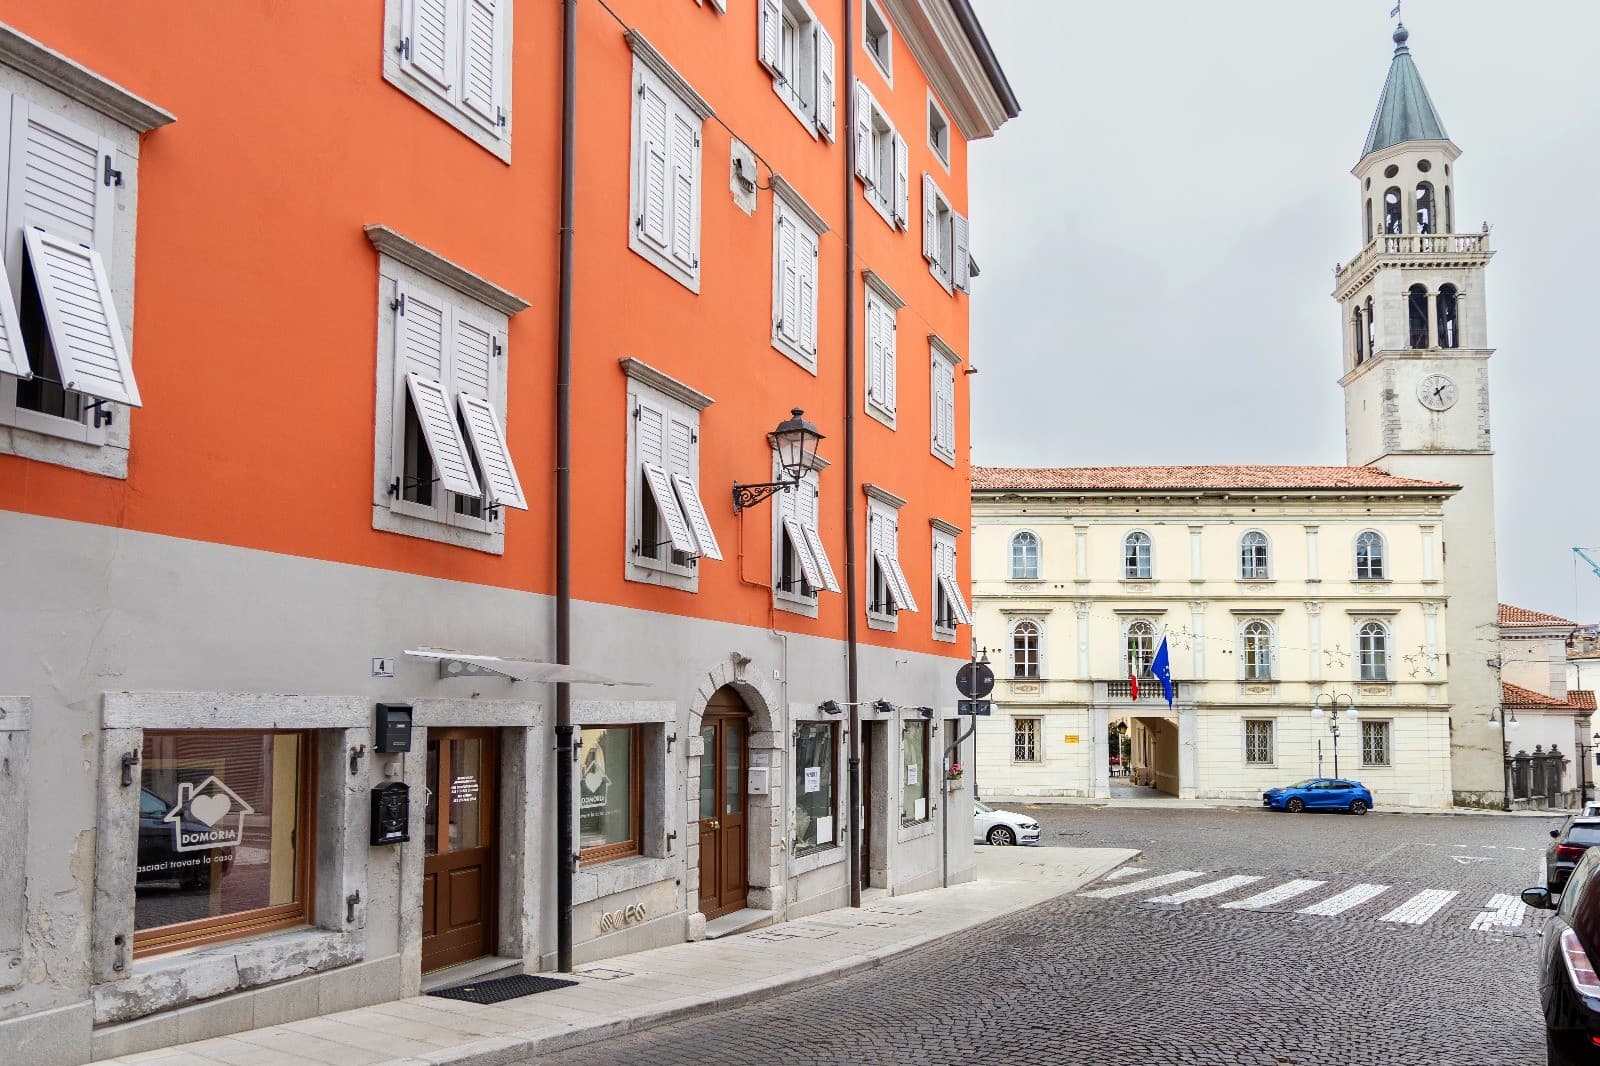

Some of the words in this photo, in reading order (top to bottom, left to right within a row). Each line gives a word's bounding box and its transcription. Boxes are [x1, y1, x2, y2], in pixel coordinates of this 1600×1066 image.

[182, 829, 236, 844] DOMORIA
[136, 861, 168, 873] asciaci
[203, 855, 211, 864] la
